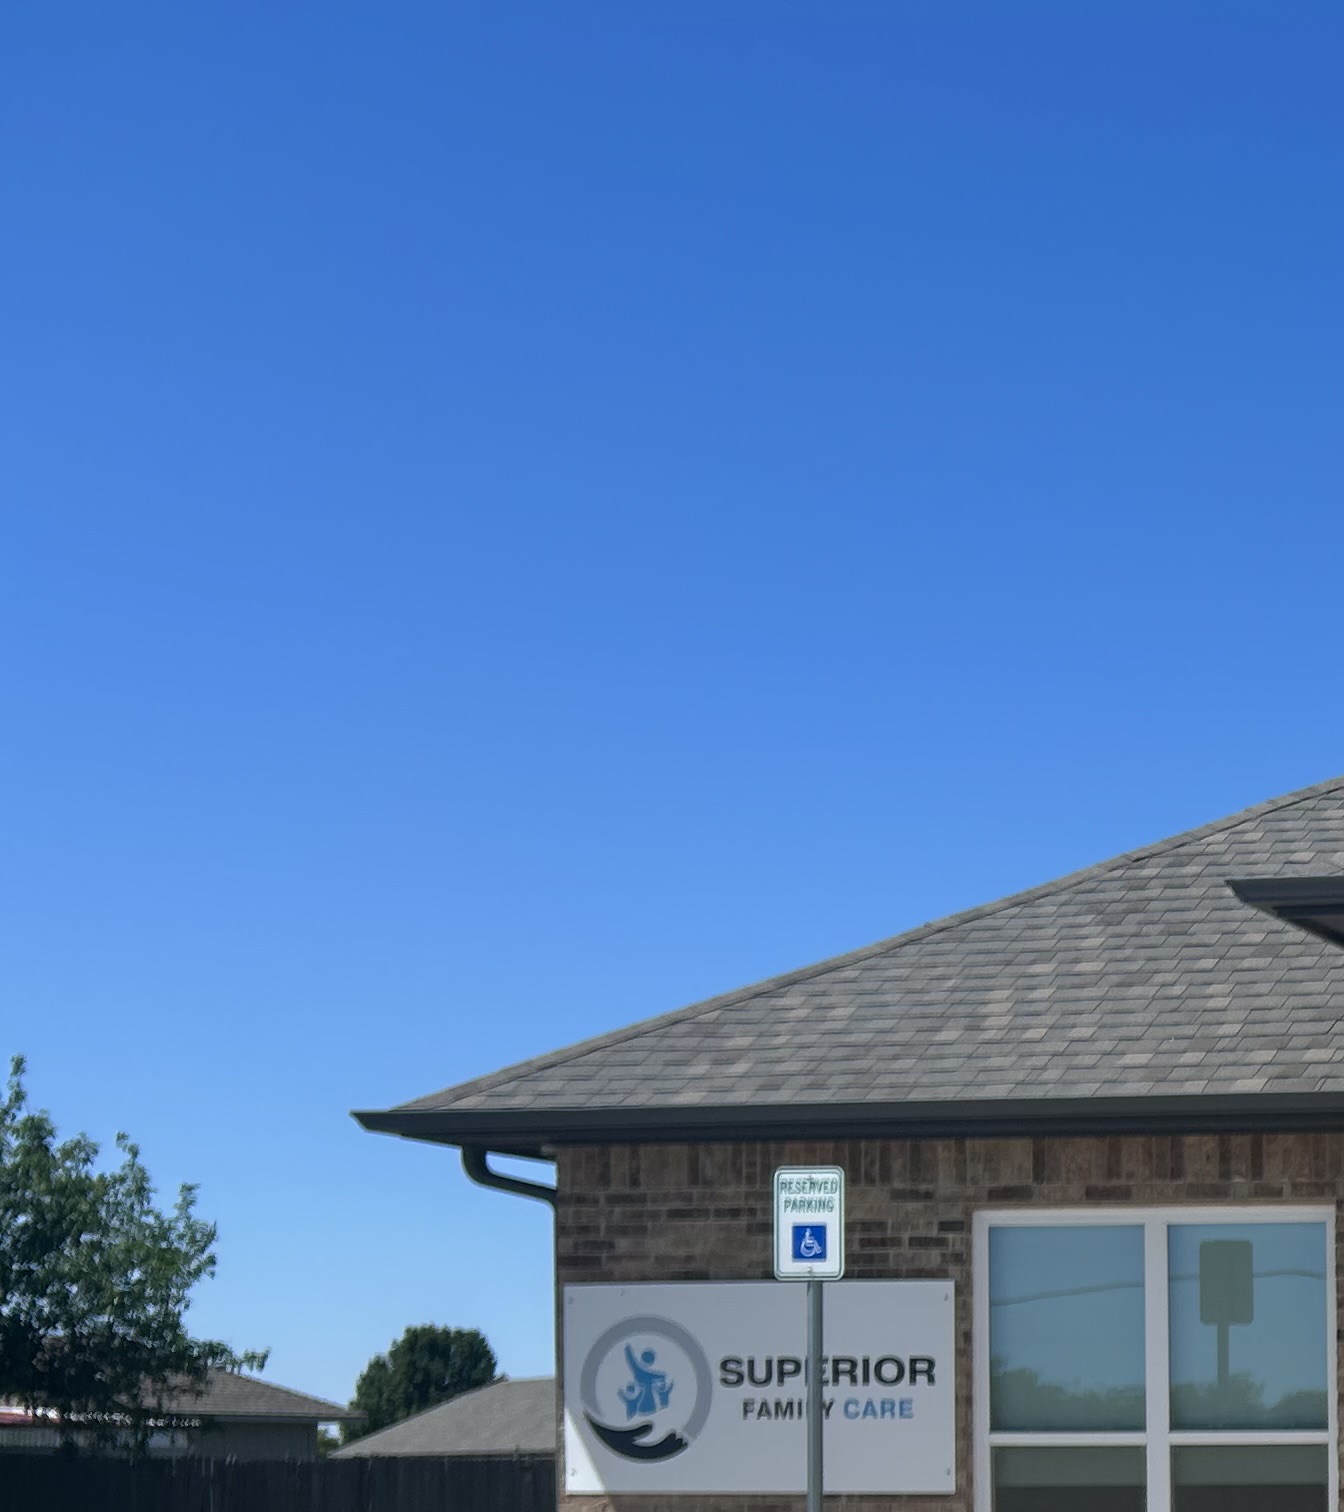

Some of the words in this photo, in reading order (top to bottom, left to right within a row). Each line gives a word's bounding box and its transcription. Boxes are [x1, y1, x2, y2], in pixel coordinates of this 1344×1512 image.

[779, 1178, 839, 1195] RESERVED
[783, 1196, 835, 1213] PARKING
[742, 1398, 835, 1420] FAMIY
[843, 1398, 914, 1420] CARE
